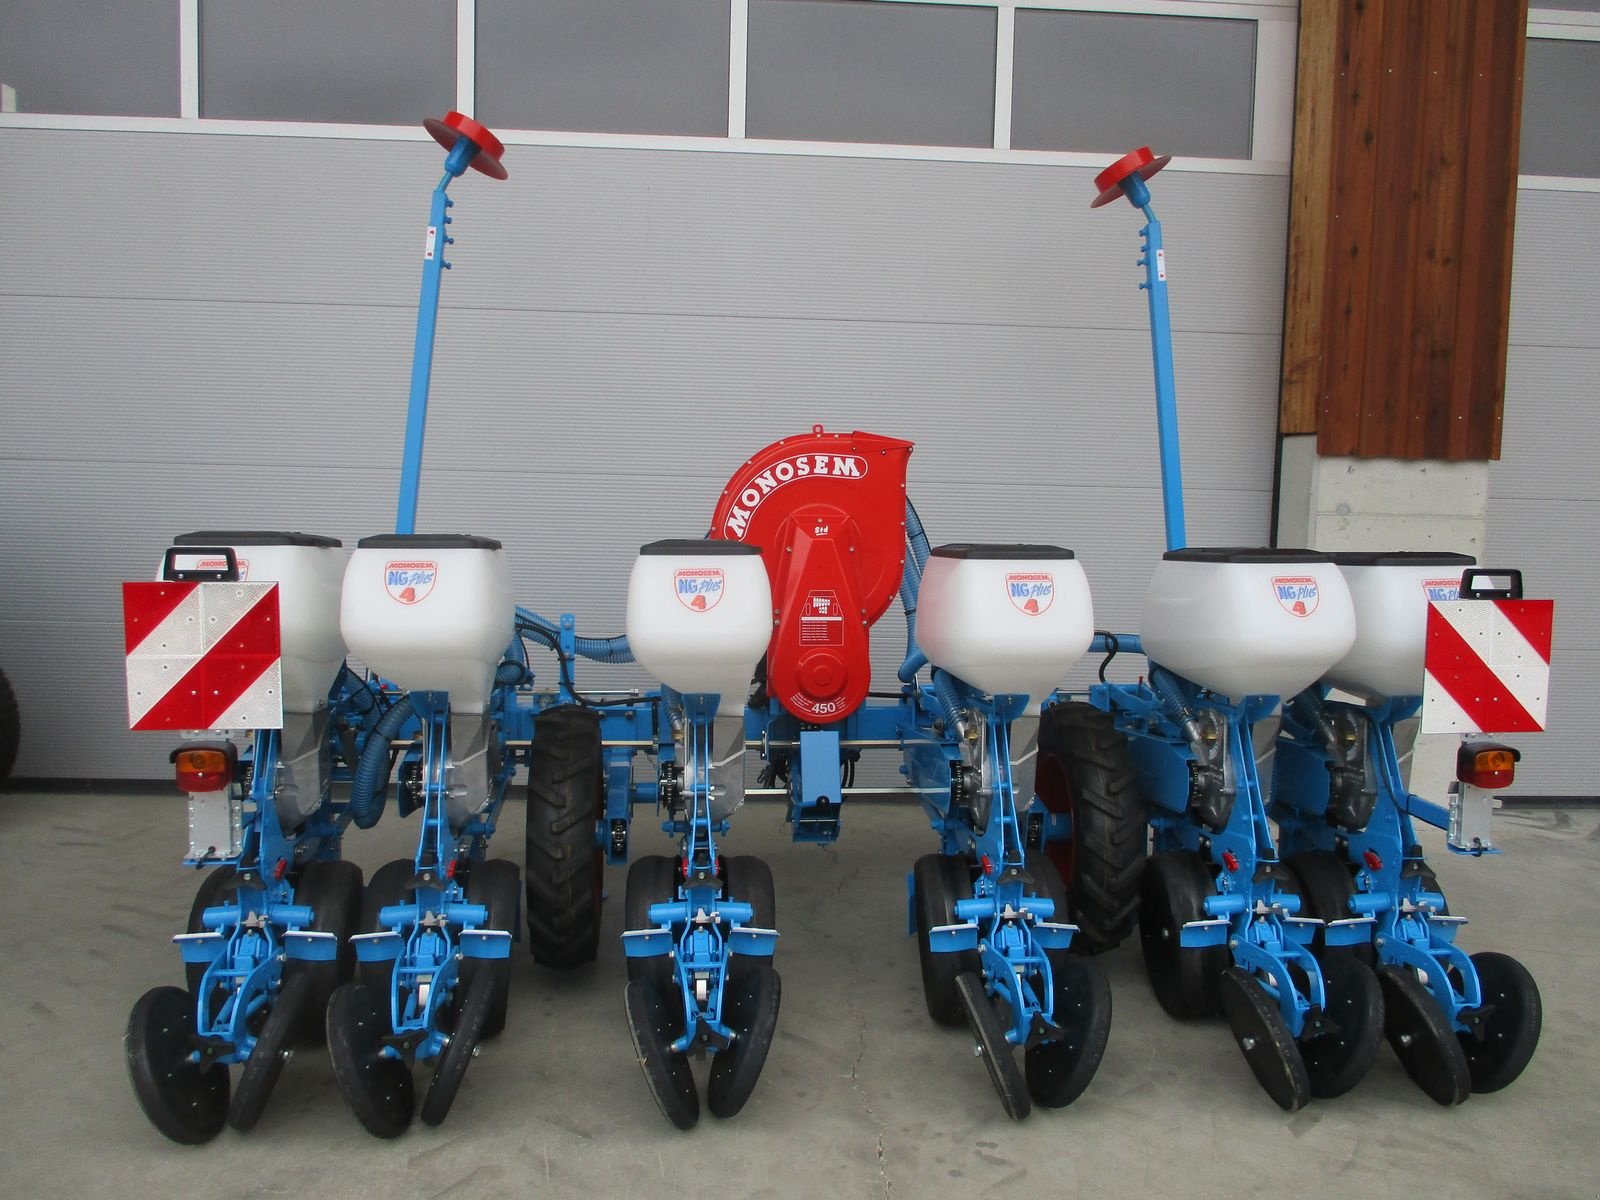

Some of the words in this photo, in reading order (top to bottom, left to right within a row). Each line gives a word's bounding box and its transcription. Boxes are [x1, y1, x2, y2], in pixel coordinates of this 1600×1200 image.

[727, 455, 860, 538] MONOSEM
[387, 570, 408, 586] NG
[678, 578, 698, 594] NG
[1010, 582, 1029, 598] NG
[1277, 585, 1296, 600] NG
[399, 587, 416, 602] 4
[690, 594, 707, 610] 4
[1427, 588, 1447, 601] NG
[1023, 598, 1039, 613] 4
[1292, 600, 1307, 615] 4
[811, 702, 836, 714] 450
